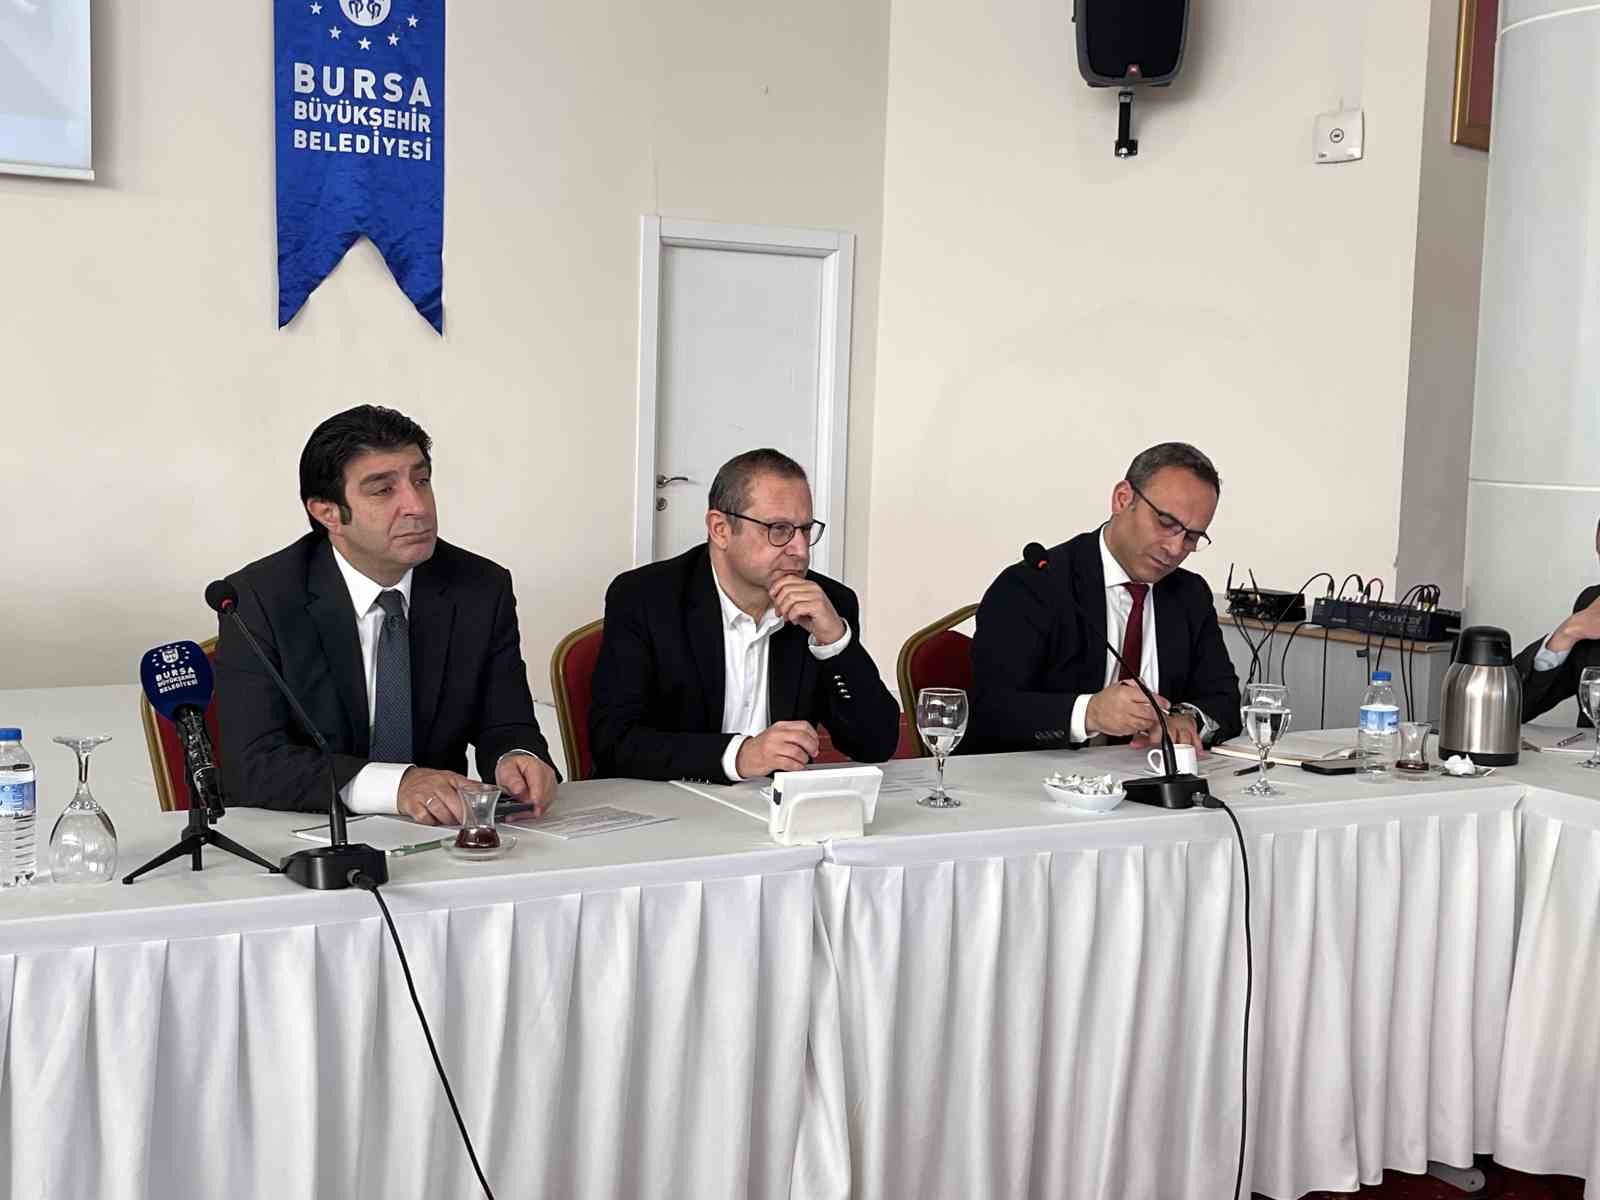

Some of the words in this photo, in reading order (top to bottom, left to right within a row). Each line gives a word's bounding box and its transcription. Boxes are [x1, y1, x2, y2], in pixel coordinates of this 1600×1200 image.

[294, 62, 432, 107] BURSA
[294, 97, 431, 133] BÜYÜKŞEHİR
[294, 129, 431, 161] BELEDİYESİ
[155, 666, 195, 682] BURSA
